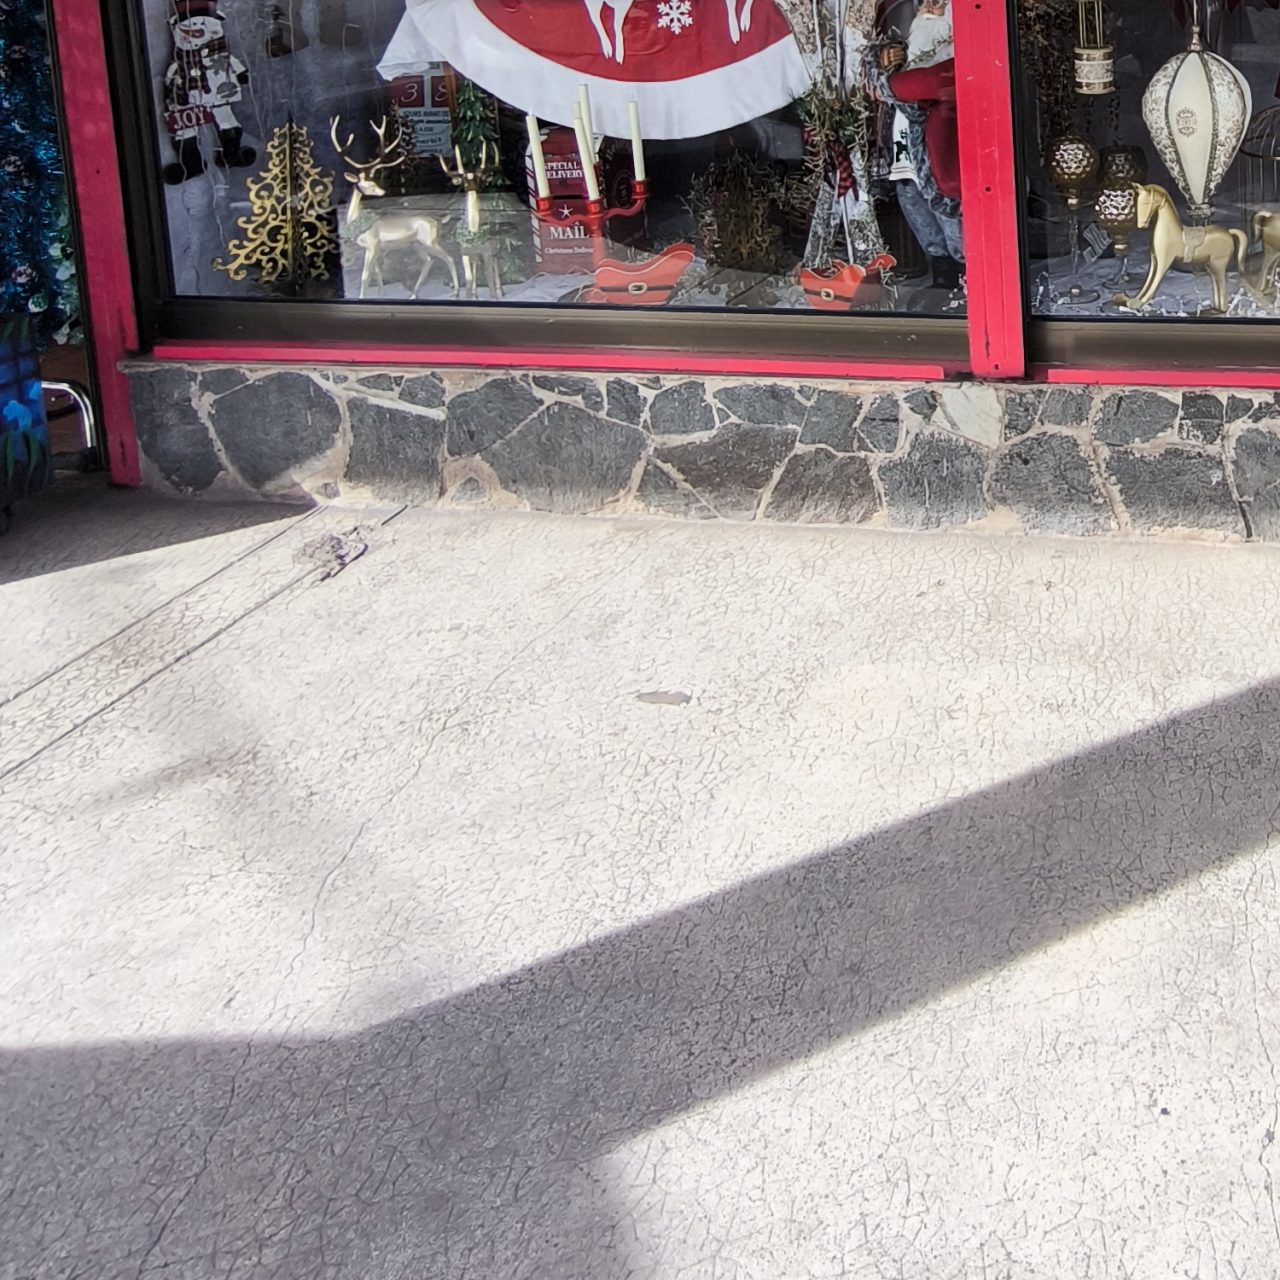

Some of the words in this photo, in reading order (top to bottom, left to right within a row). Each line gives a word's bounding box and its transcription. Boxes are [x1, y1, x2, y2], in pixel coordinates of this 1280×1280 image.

[401, 83, 418, 102] 3
[174, 107, 206, 129] JOY
[549, 225, 590, 240] MAIL
